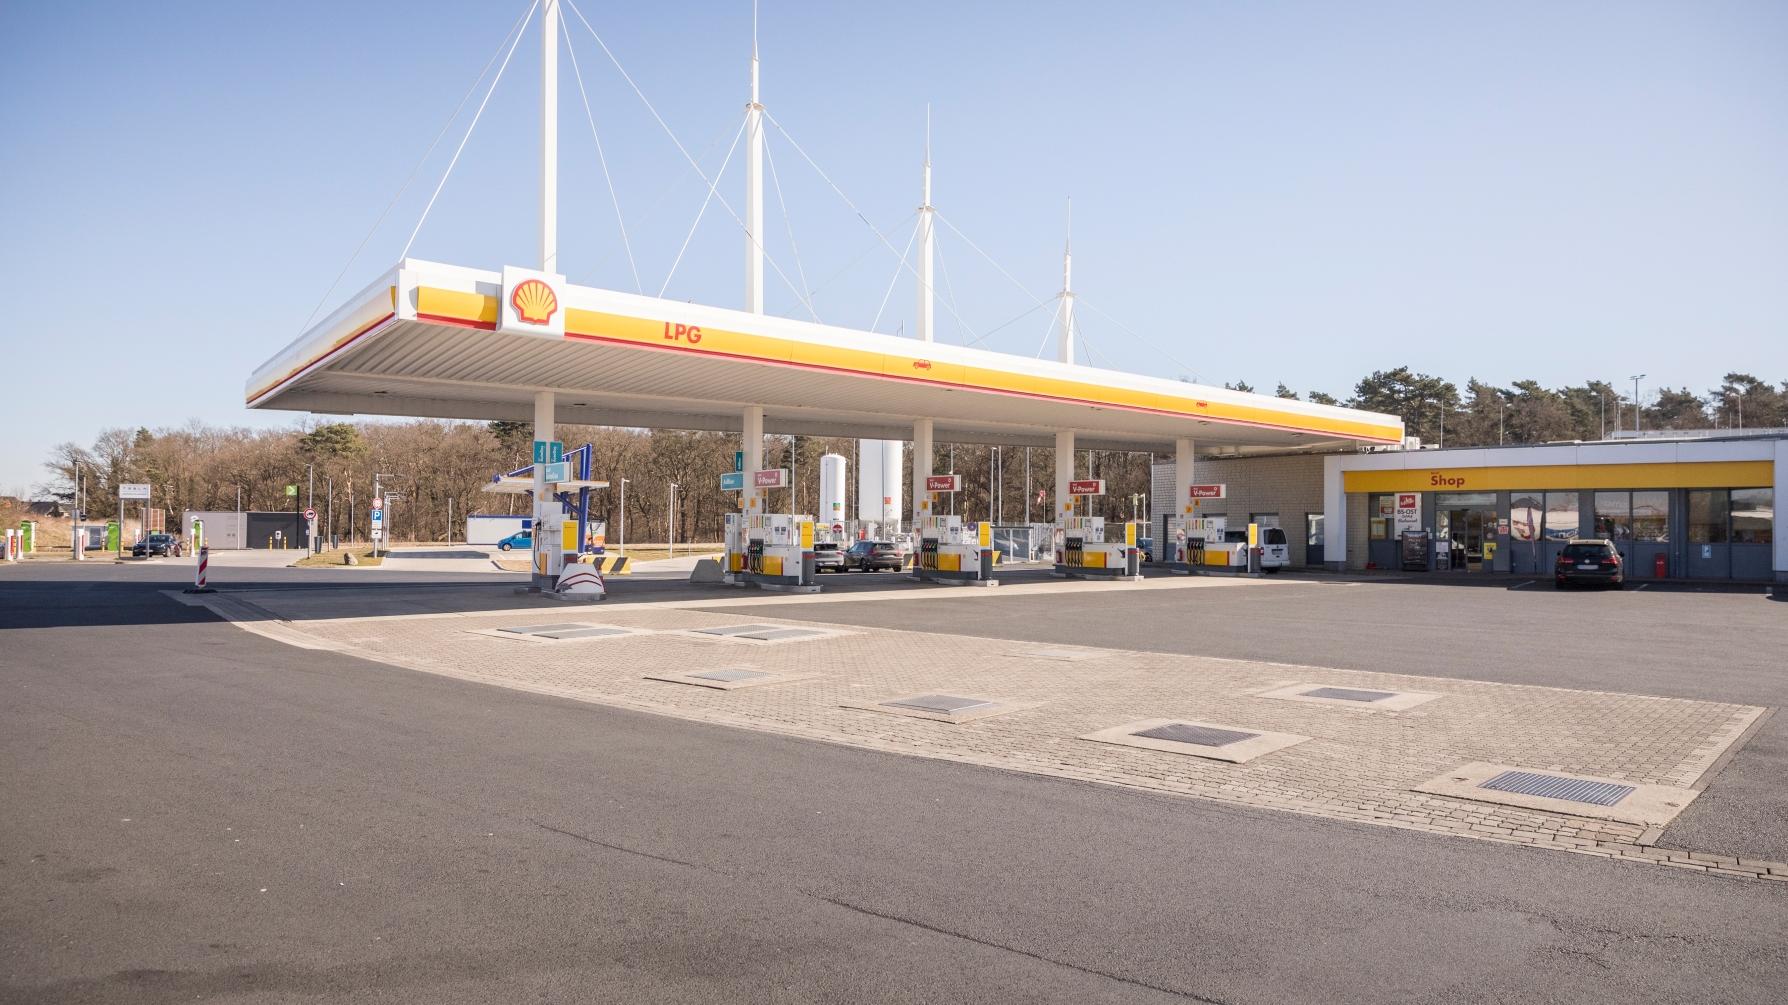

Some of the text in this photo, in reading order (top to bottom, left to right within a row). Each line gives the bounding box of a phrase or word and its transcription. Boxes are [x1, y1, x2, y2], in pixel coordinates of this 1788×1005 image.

[664, 321, 702, 344] LPG
[757, 476, 777, 485] V-Power
[929, 481, 951, 489] V-Power
[1431, 475, 1465, 488] Shop
[374, 511, 380, 519] P
